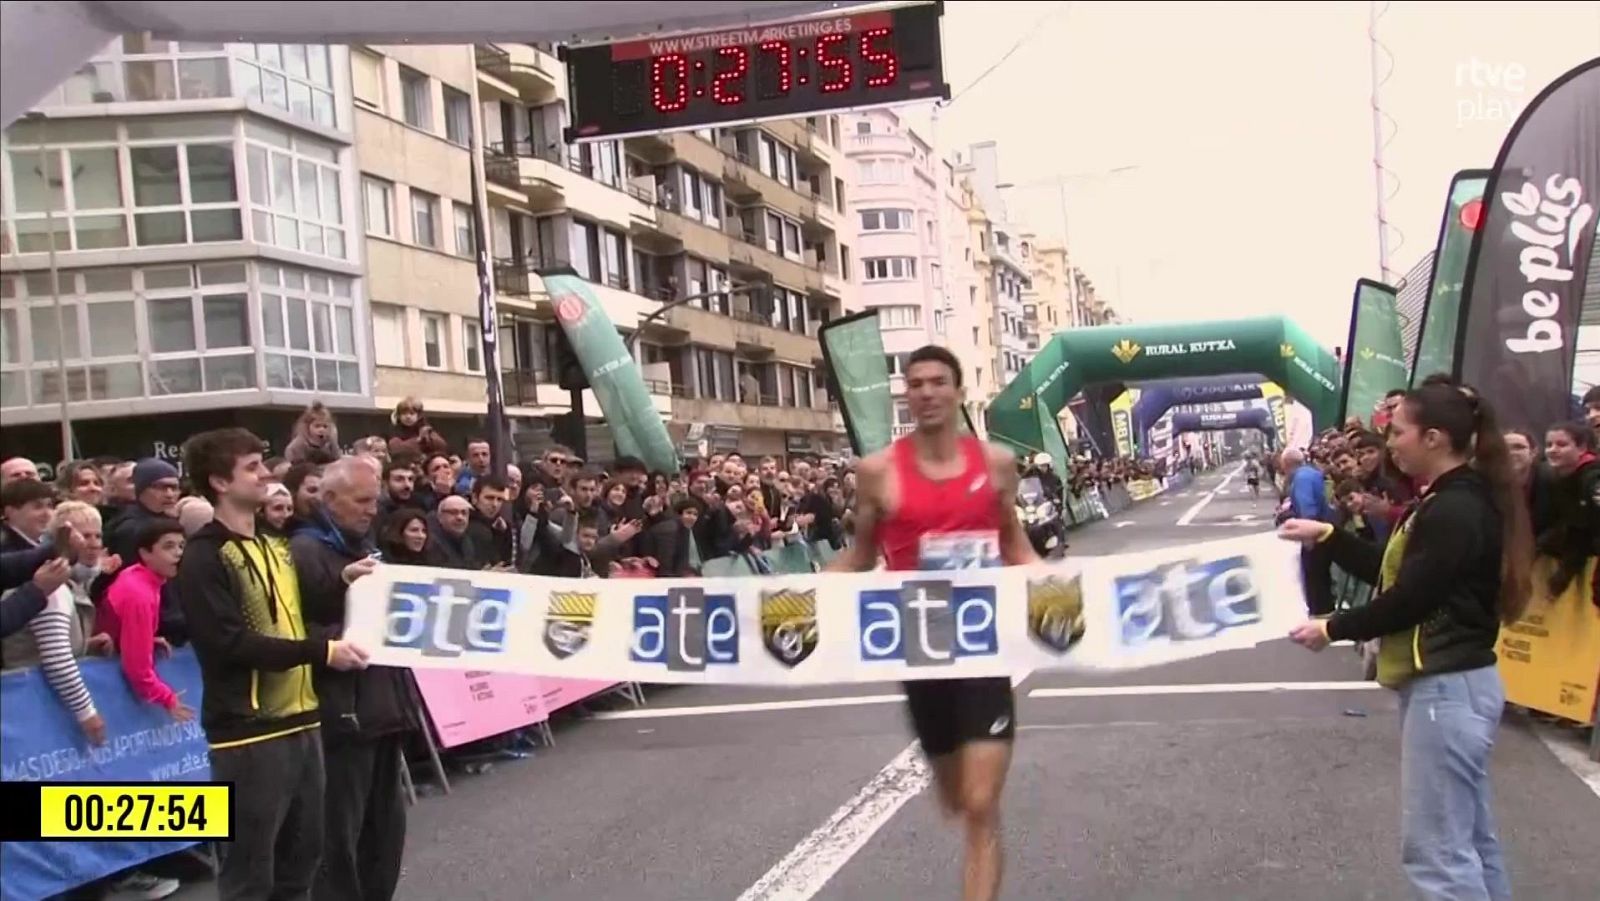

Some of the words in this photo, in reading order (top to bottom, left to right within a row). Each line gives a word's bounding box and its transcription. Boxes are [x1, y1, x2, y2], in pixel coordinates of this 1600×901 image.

[650, 17, 852, 55] WWW.STREETMARKETING.ES
[651, 28, 898, 113] 0:27:55
[1508, 173, 1583, 282] plus
[1145, 343, 1187, 356] RURAL
[1189, 339, 1236, 353] KUTXA
[1505, 289, 1563, 353] be
[383, 585, 510, 652] ate
[633, 594, 736, 665] ate
[863, 587, 993, 660] ate
[1120, 563, 1262, 645] ate
